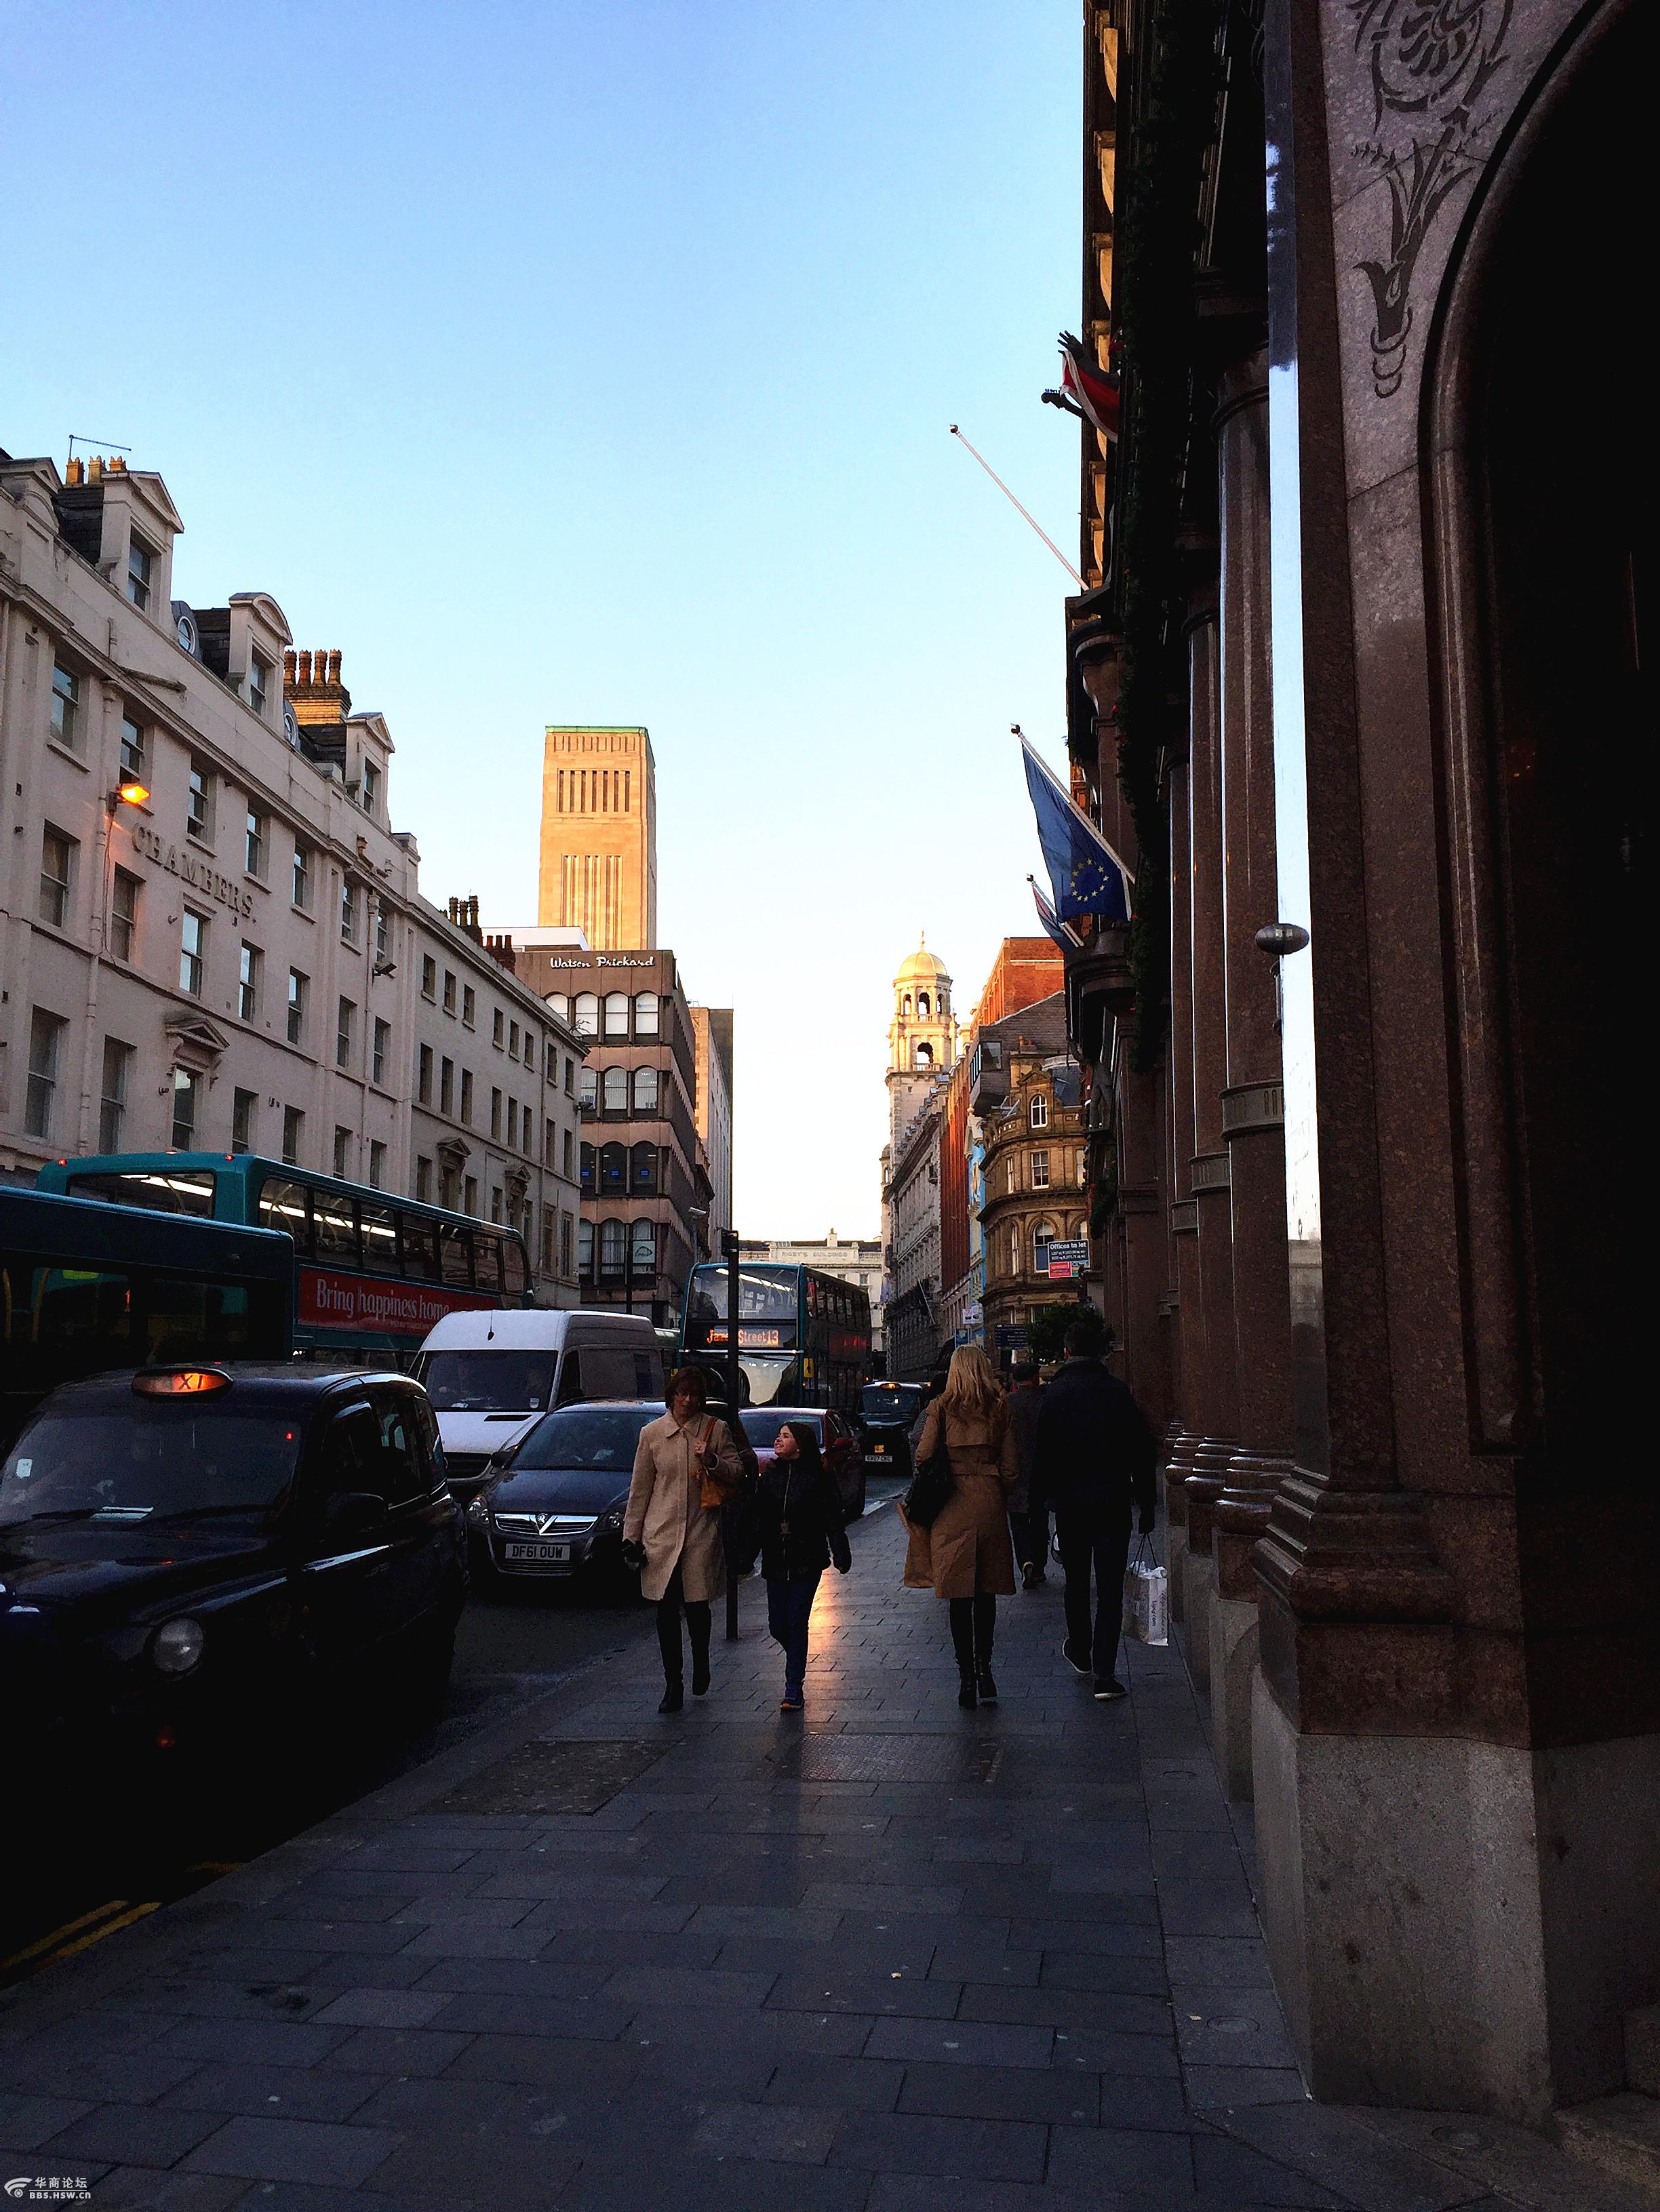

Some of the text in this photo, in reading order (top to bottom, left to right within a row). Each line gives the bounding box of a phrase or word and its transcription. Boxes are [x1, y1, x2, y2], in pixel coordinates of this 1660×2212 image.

[550, 956, 655, 969] Watson Prickard
[317, 1279, 355, 1319] Bring
[357, 1285, 418, 1322] happiness
[738, 1329, 766, 1344] Street
[767, 1329, 780, 1345] 13
[511, 1545, 537, 1558] DF61
